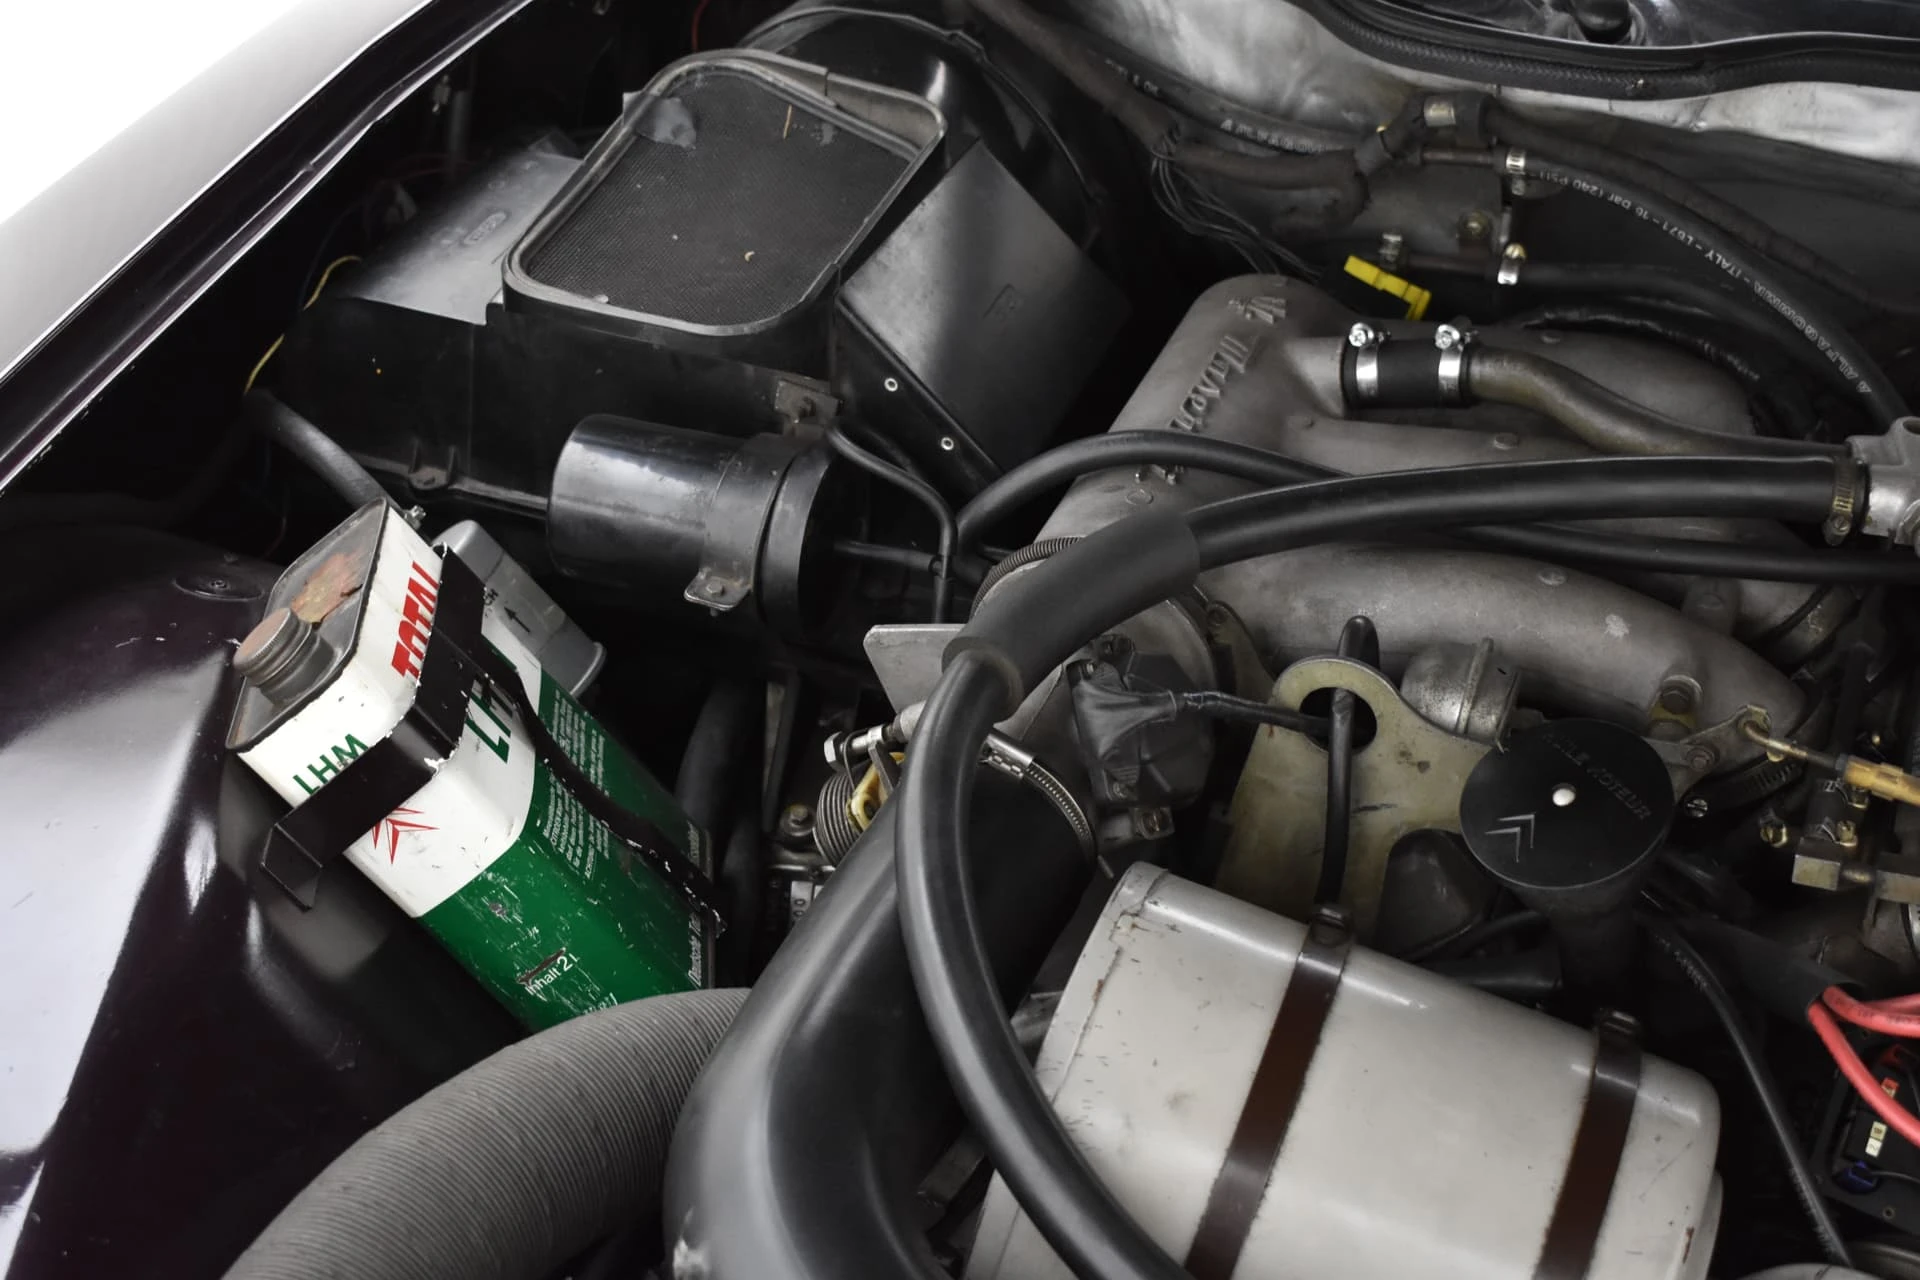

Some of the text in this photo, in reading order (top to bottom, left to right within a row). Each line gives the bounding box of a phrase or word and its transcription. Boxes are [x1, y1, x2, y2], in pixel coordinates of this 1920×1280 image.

[1606, 193, 1632, 210] bar
[1704, 249, 1742, 279] ITALY
[525, 966, 562, 996] Inhalt
[557, 956, 573, 972] 2
